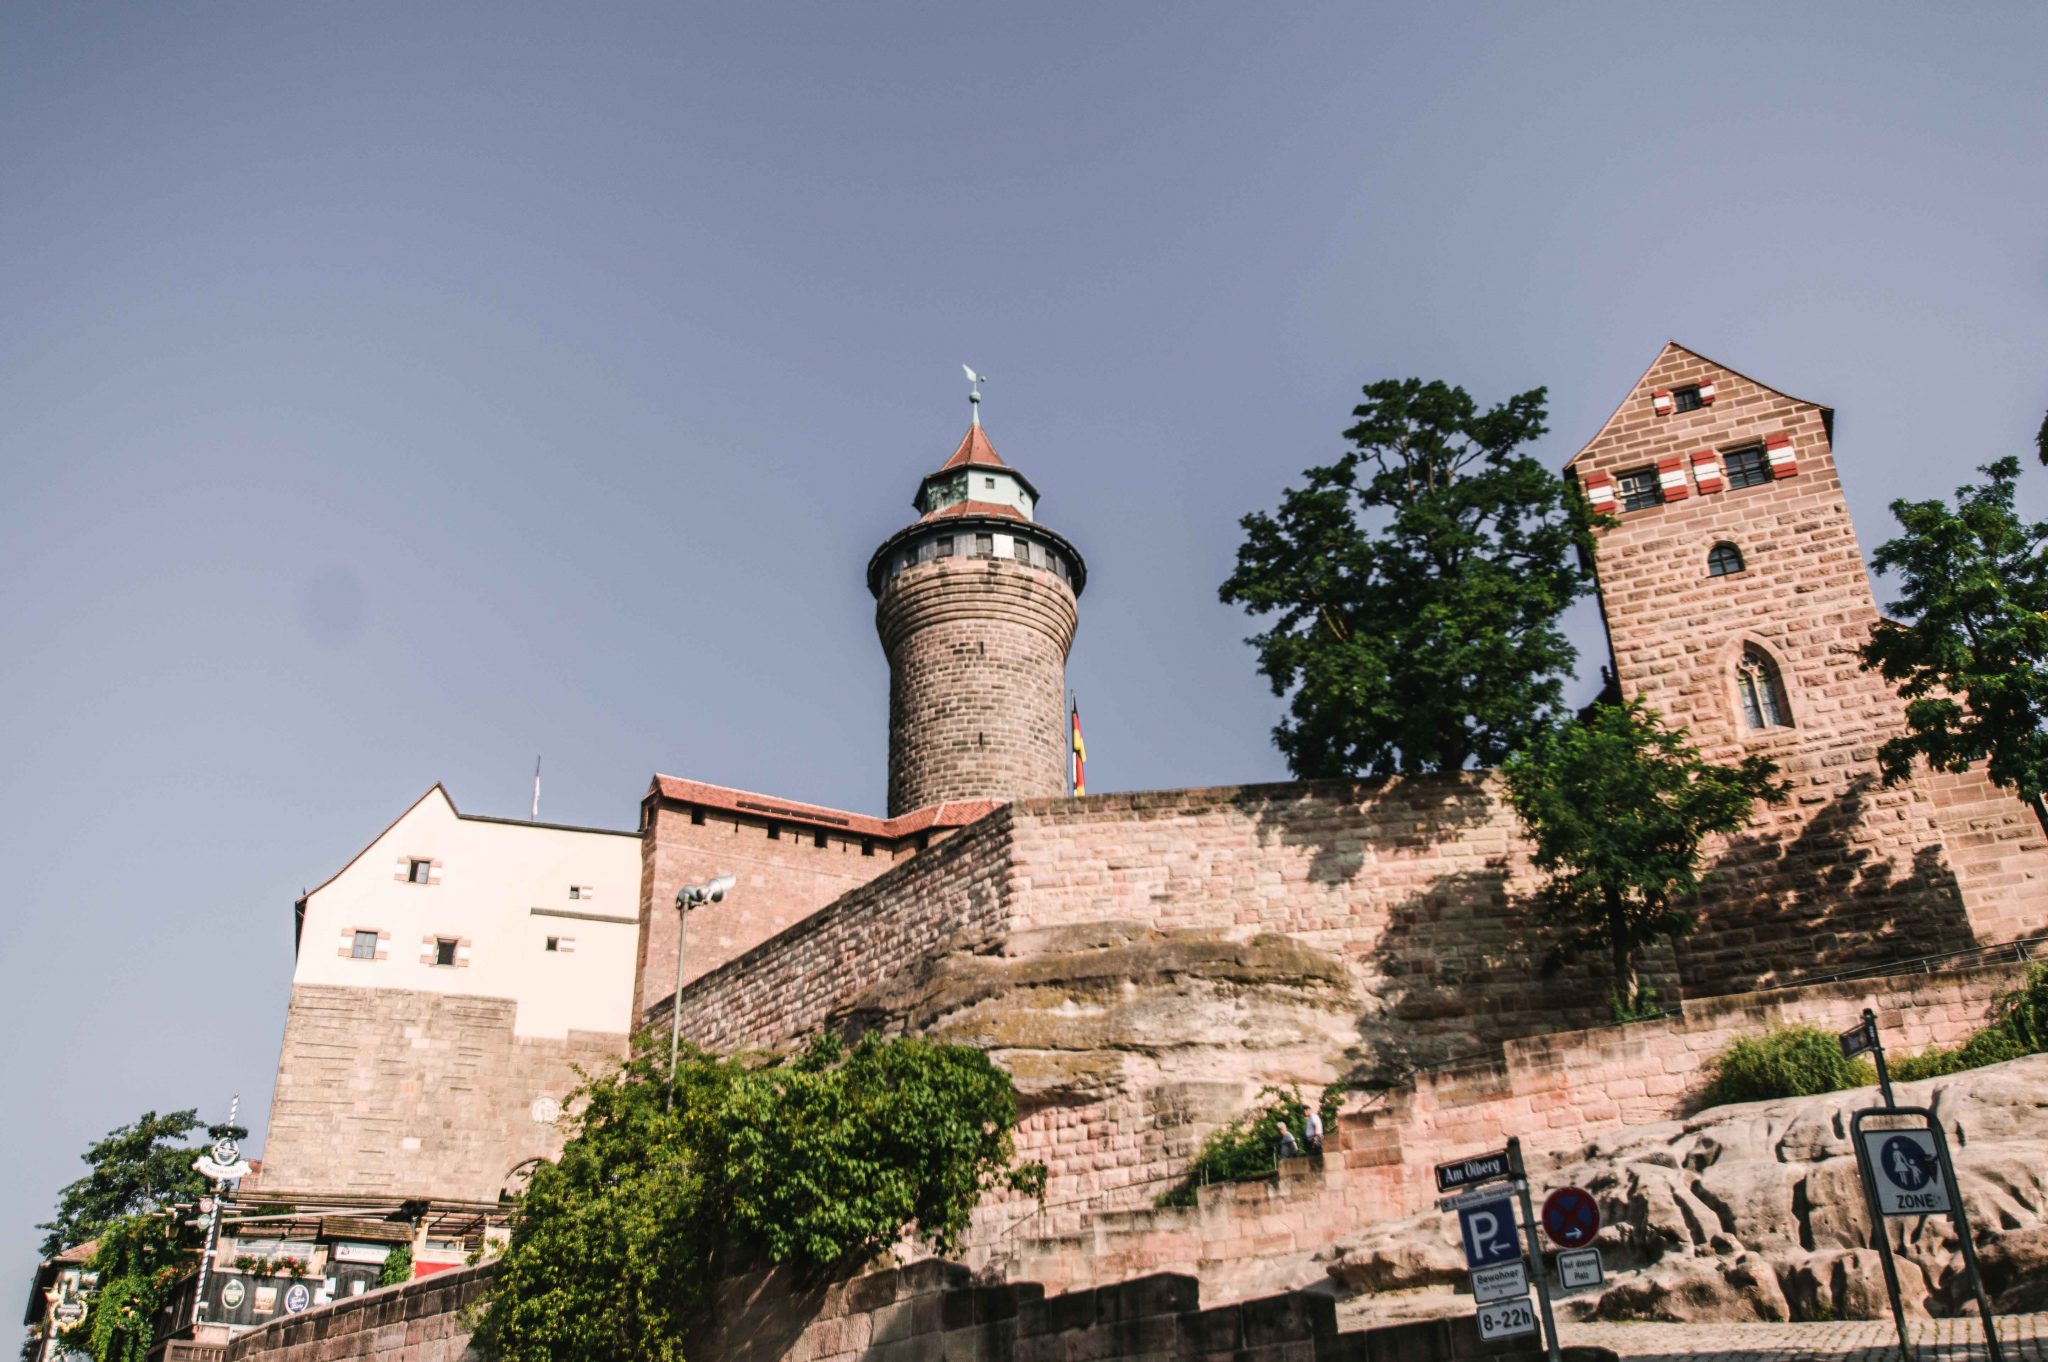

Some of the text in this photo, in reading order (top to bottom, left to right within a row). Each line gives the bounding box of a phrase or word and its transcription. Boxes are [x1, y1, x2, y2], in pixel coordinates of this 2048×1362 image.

[1445, 1159, 1501, 1183] Am Ölberg
[1896, 1193, 1935, 1208] ZONE
[1468, 1211, 1498, 1260] P
[1476, 1269, 1519, 1284] Bewohner
[1483, 1307, 1531, 1331] 8-22h
